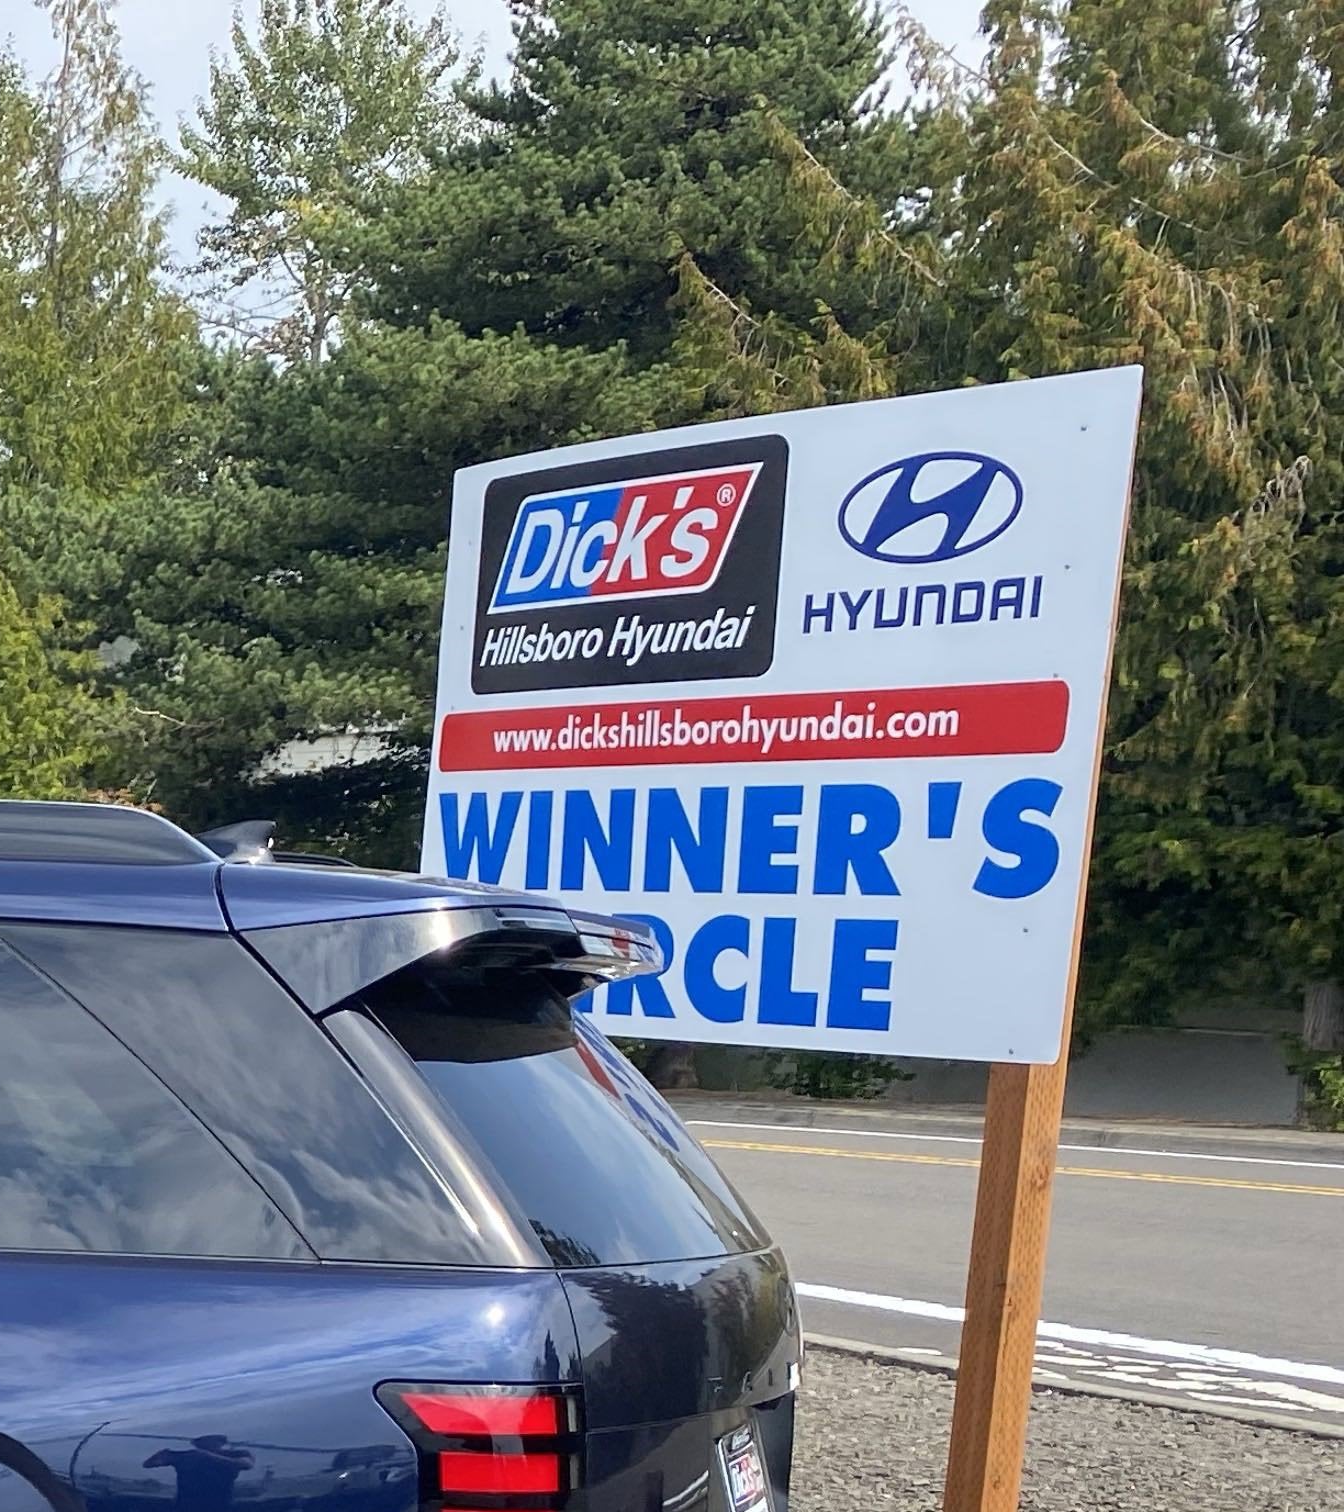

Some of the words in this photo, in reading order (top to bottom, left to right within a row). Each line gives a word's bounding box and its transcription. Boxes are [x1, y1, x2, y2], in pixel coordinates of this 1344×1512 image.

[507, 486, 717, 594] Dick's
[480, 622, 603, 667] Hillsboro
[607, 605, 756, 667] Hyundai
[802, 576, 1043, 634] HYUNDAI
[492, 702, 960, 753] www.dickshillsborohyundai.com
[439, 779, 1064, 898] WINNER'S
[570, 914, 899, 1031] RCLE
